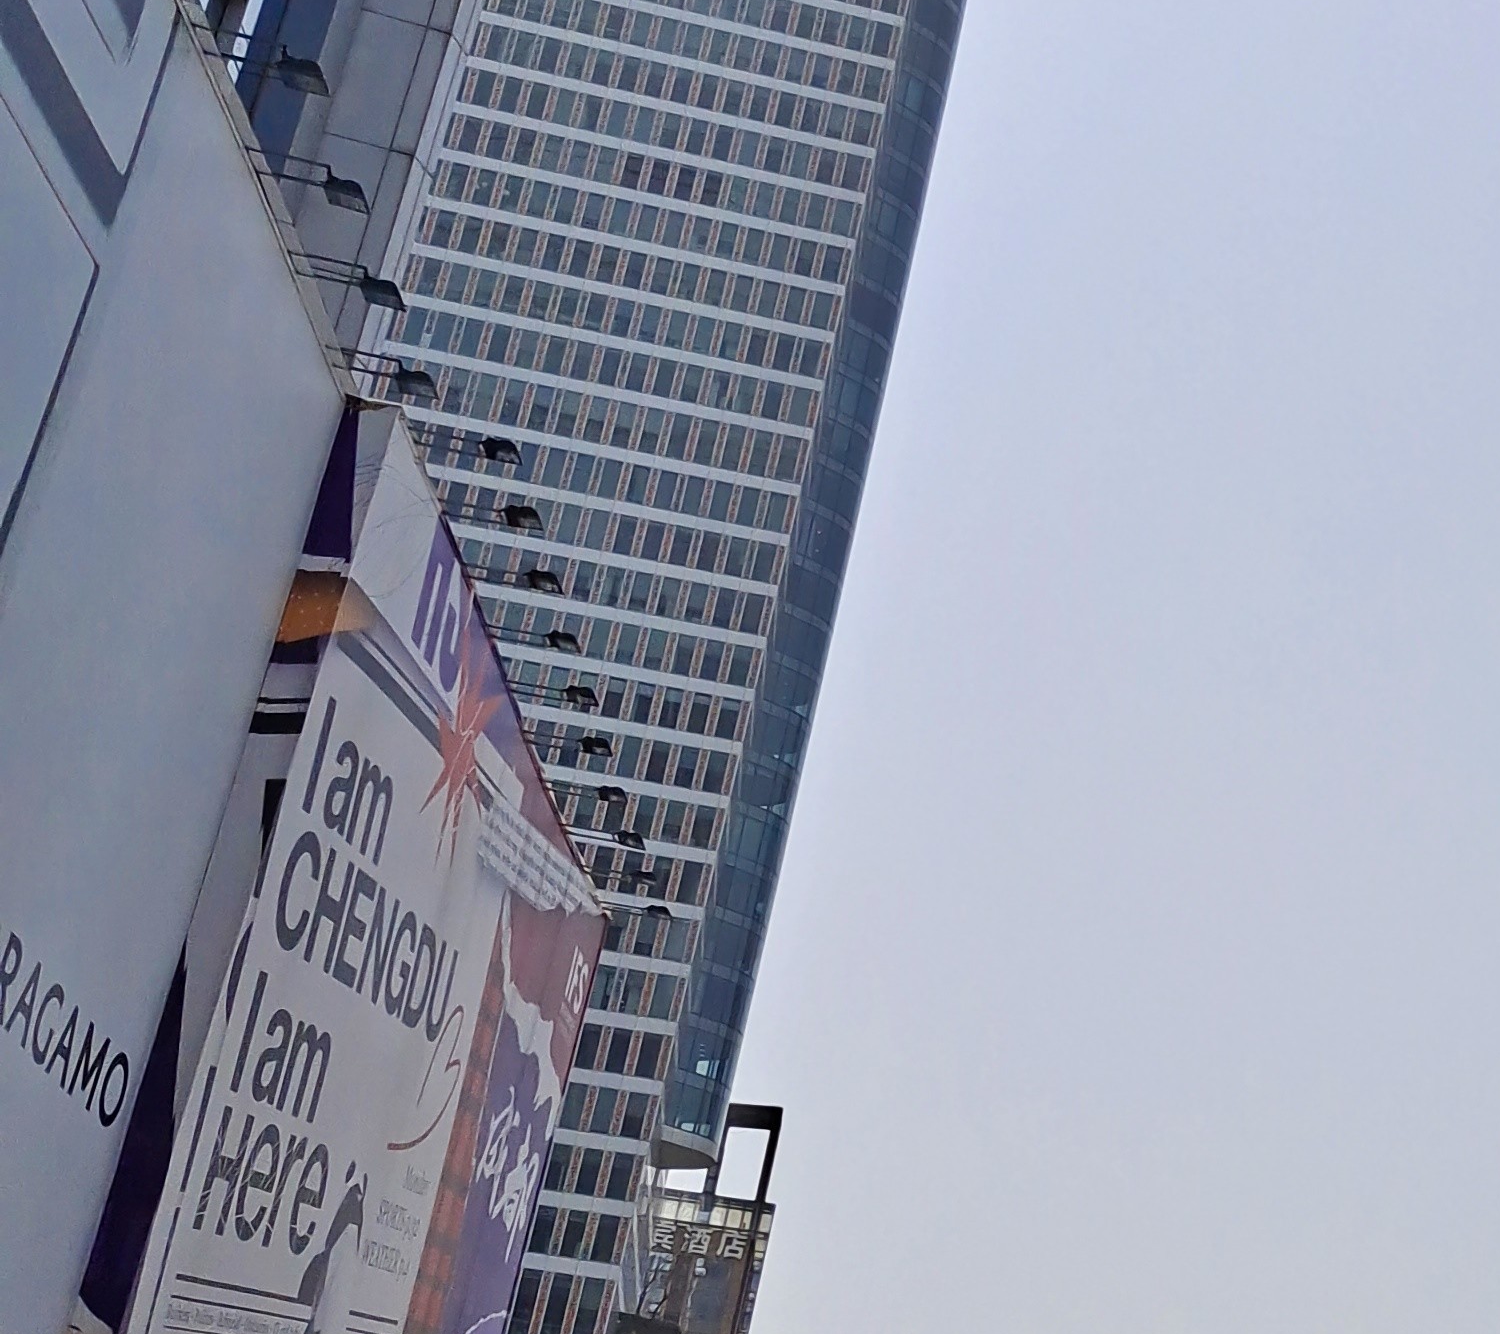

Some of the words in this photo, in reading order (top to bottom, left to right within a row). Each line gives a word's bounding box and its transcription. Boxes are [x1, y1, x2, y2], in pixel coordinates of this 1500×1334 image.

[323, 740, 394, 866] am
[275, 830, 458, 1042] CHENGDU
[252, 1008, 331, 1124] am
[192, 1105, 329, 1255] Here
